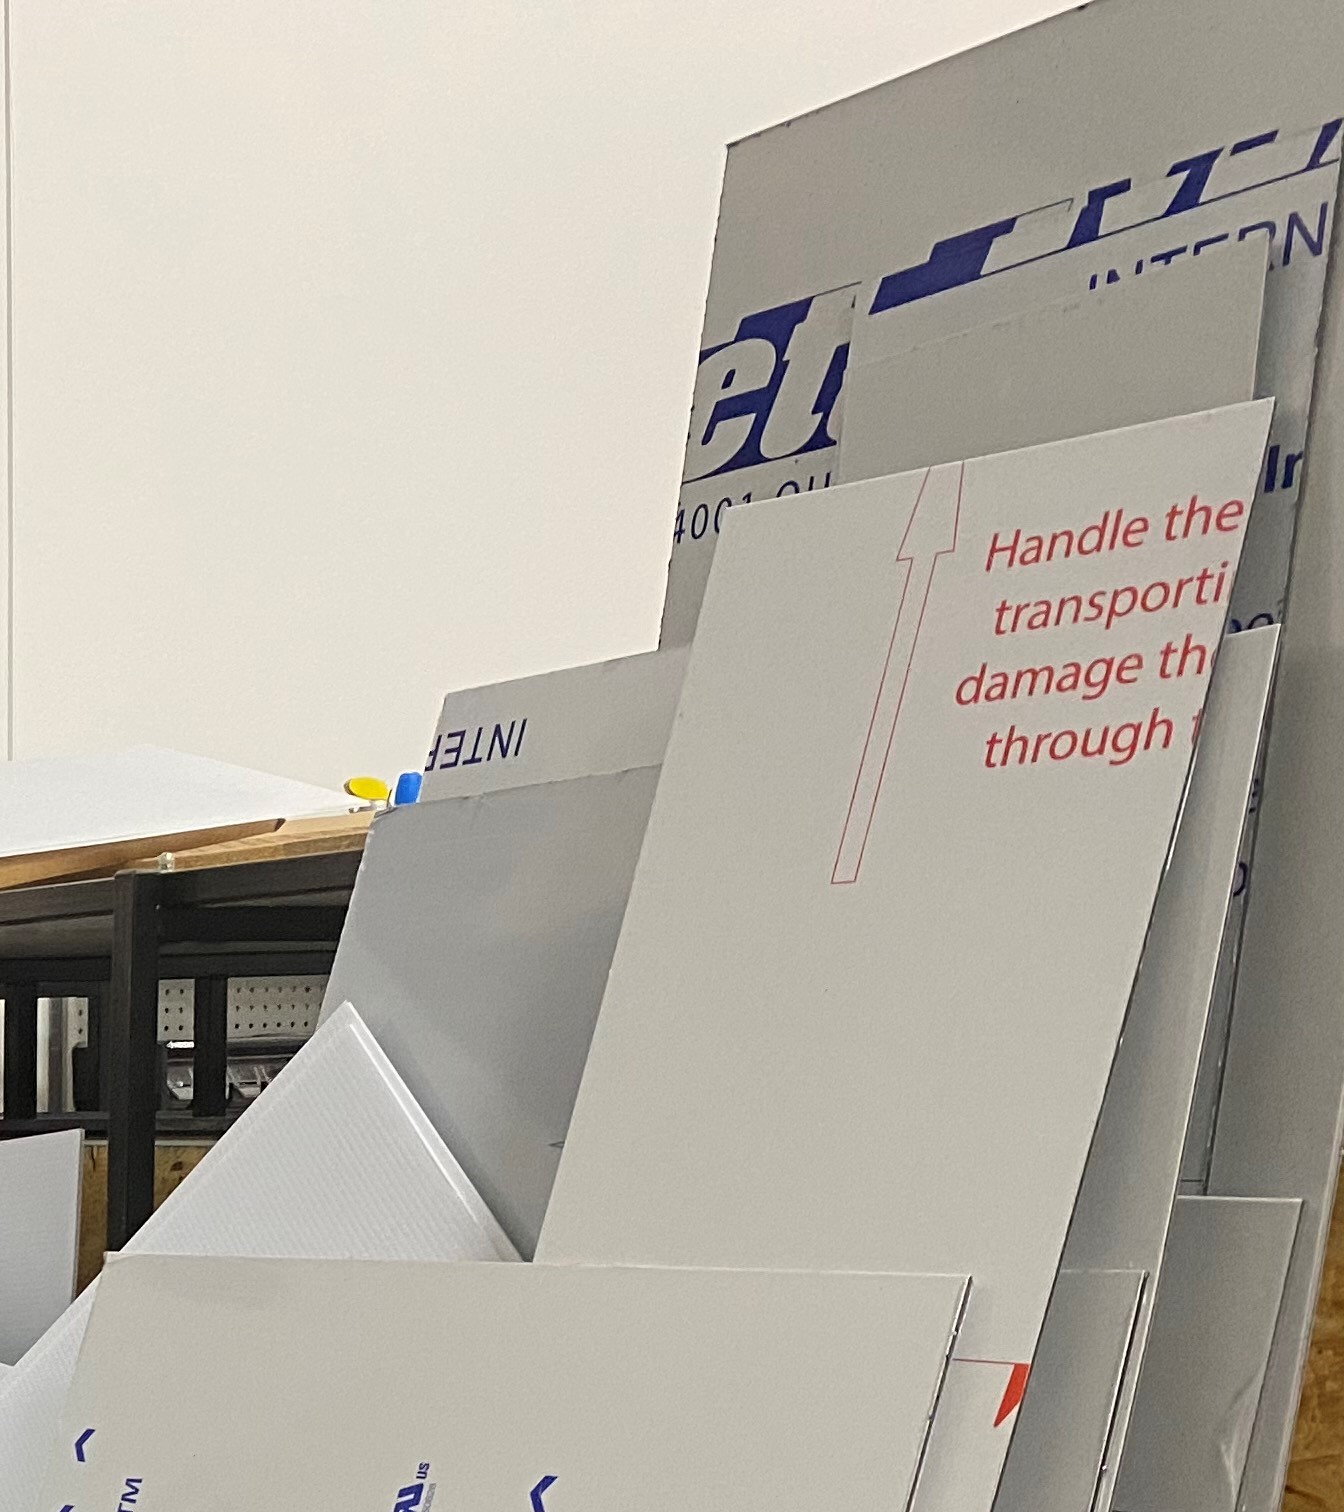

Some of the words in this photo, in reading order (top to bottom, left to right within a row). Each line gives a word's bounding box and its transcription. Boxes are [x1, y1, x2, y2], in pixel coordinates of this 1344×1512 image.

[985, 510, 1150, 572] Handle
[1164, 496, 1244, 542] the
[955, 628, 1144, 706] damage
[984, 707, 1174, 769] through
